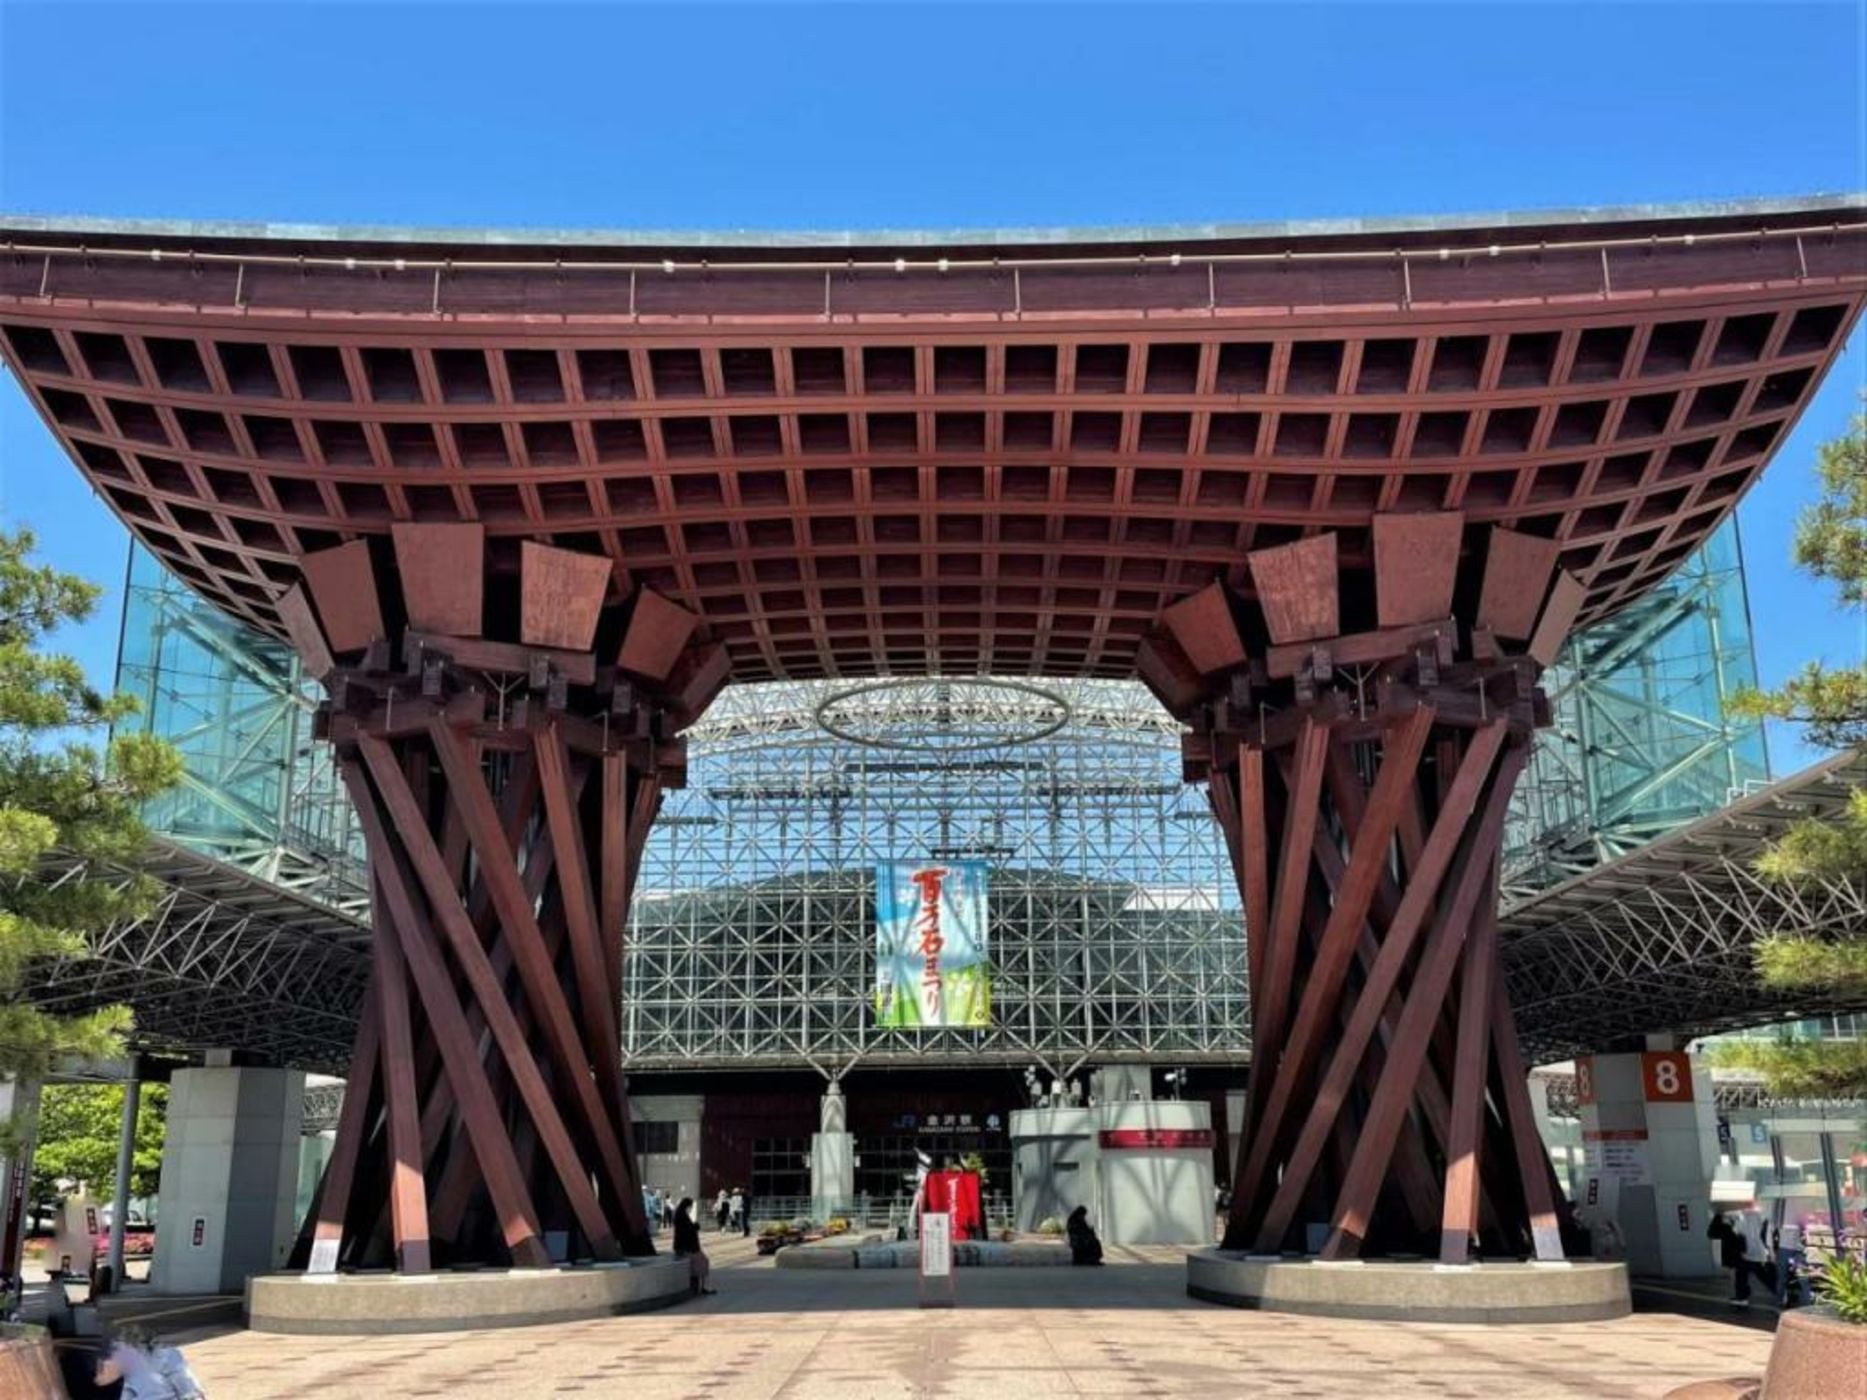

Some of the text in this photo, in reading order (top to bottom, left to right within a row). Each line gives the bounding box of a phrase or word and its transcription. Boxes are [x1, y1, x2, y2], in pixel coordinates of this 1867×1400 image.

[912, 868, 949, 1017] 百万石まつり
[1656, 1060, 1679, 1094] 8
